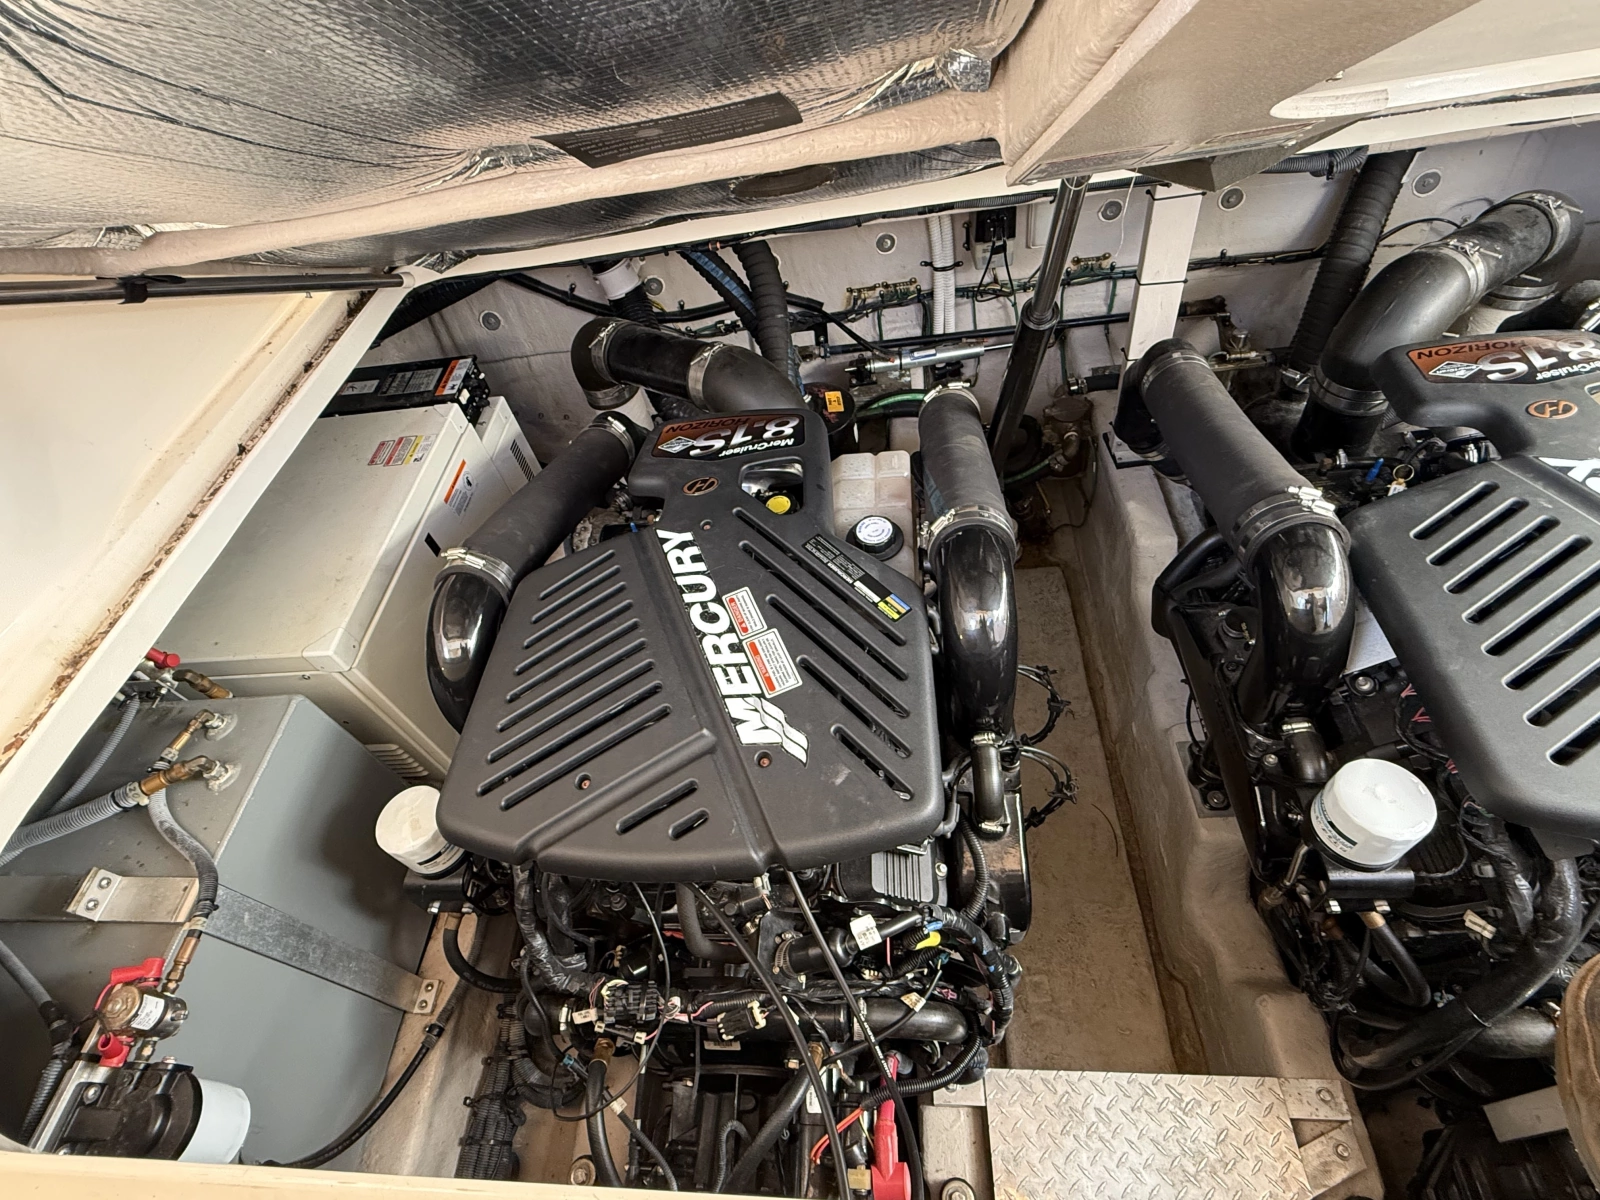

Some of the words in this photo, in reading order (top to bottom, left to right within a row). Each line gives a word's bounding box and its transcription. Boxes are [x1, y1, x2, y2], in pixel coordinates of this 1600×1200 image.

[1416, 341, 1528, 360] HORIZON
[1535, 360, 1600, 380] erCruiser
[665, 416, 749, 434] HORIZON
[690, 416, 799, 458] 8.1S
[718, 438, 795, 458] MerCruiser
[656, 528, 792, 749] MERCURY
